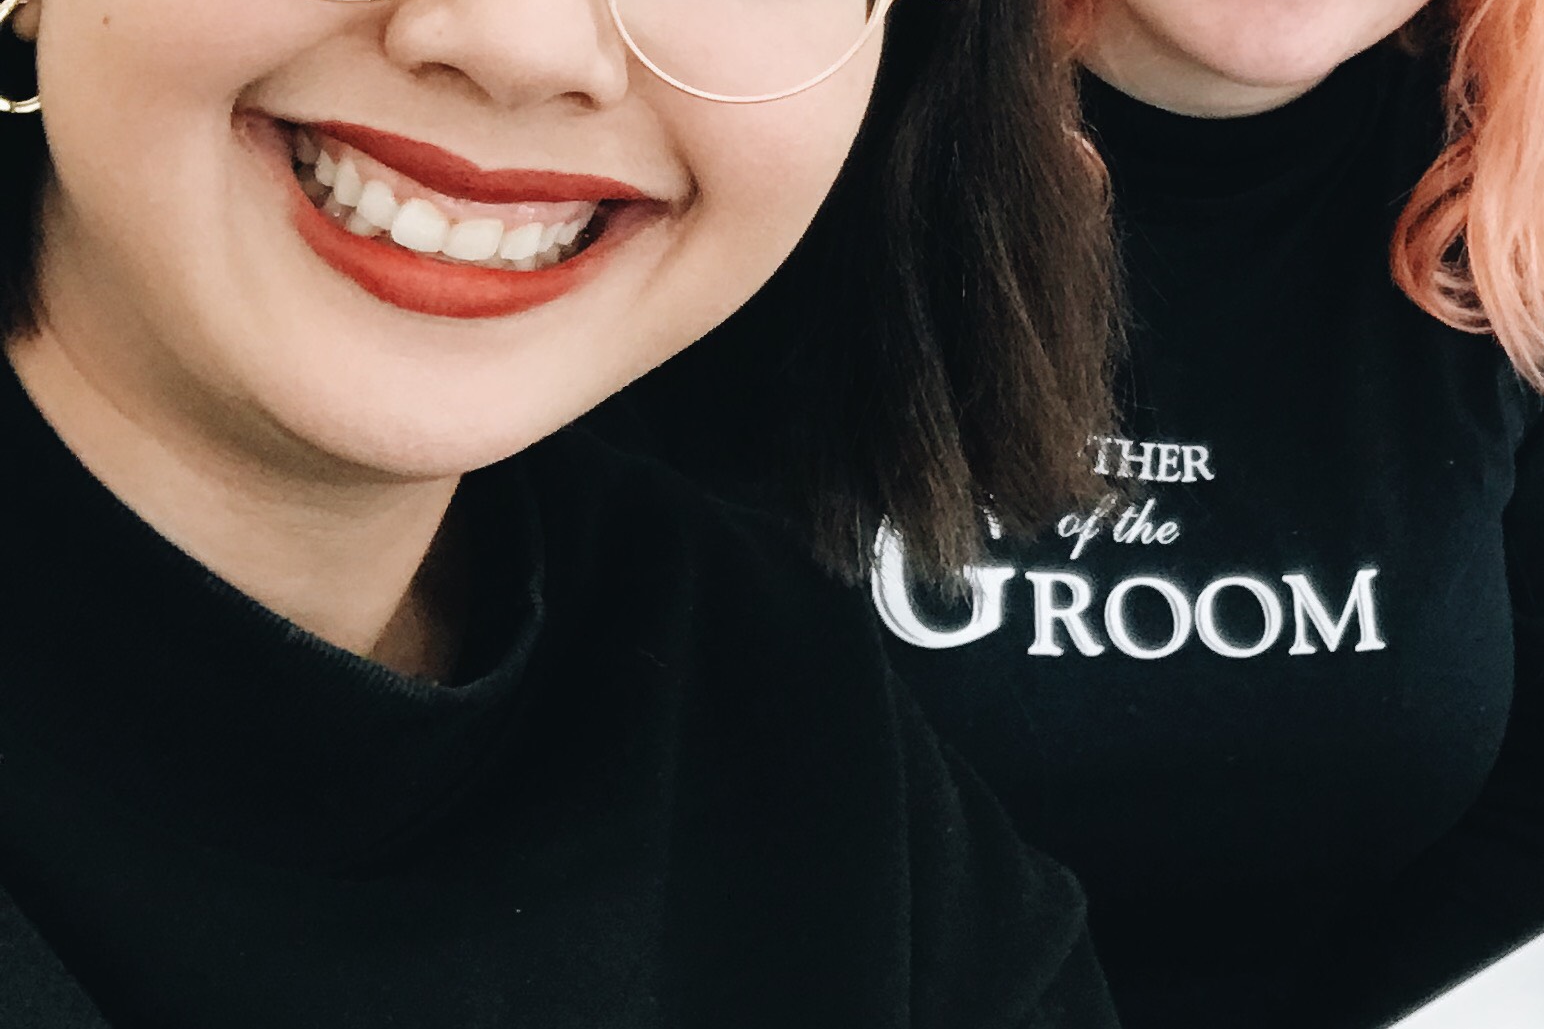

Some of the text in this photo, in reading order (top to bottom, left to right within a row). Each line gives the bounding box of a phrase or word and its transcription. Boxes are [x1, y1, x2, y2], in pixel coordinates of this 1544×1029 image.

[1077, 435, 1215, 483] THER
[1057, 493, 1181, 560] of the
[871, 492, 1387, 659] GROOM
